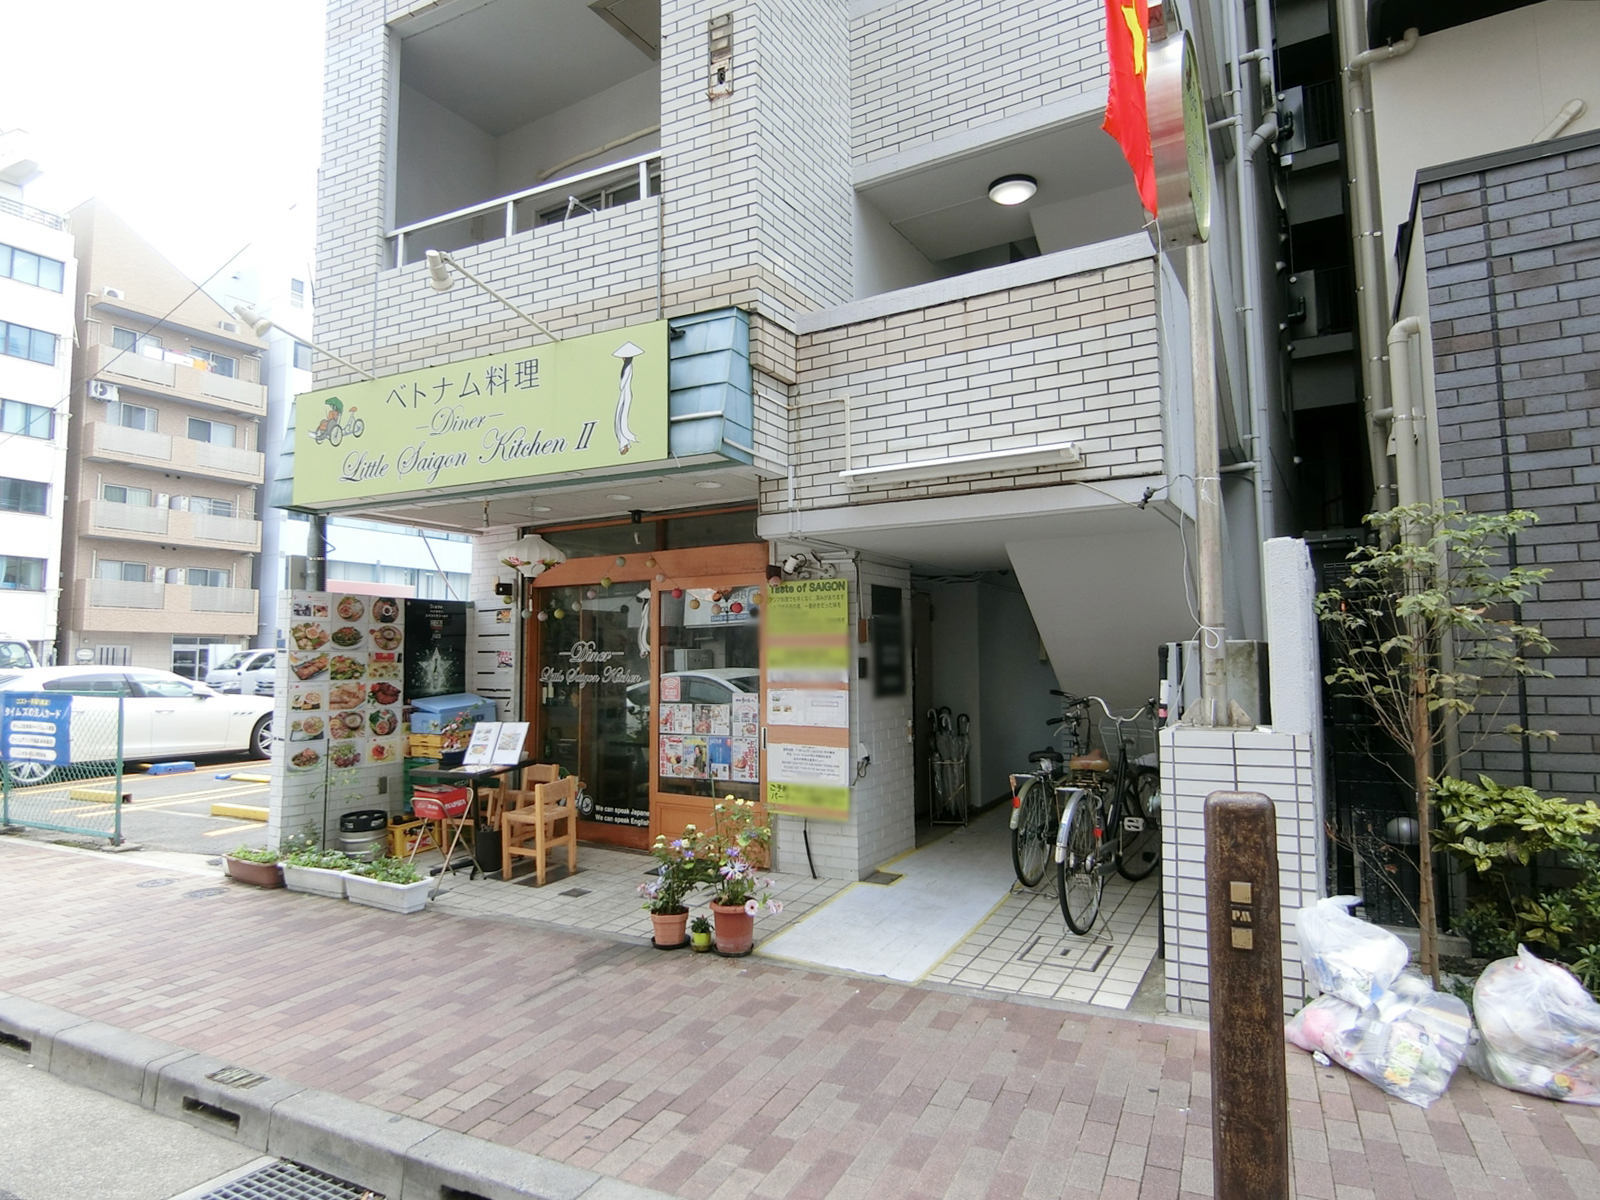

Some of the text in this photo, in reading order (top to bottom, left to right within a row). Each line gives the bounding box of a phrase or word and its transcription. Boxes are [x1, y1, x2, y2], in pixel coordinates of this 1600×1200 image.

[386, 358, 540, 409] ベトナム料理
[429, 404, 487, 437] Diner
[338, 450, 390, 483] Little
[396, 440, 470, 485] Saigon
[478, 425, 568, 465] Kitchen
[796, 582, 808, 593] of
[809, 580, 846, 593] SAIGON
[568, 640, 613, 663] Diner
[539, 665, 642, 689] Little Saigon Kitchen
[614, 807, 630, 815] speak
[630, 808, 650, 817] Japane
[614, 816, 630, 824] speak
